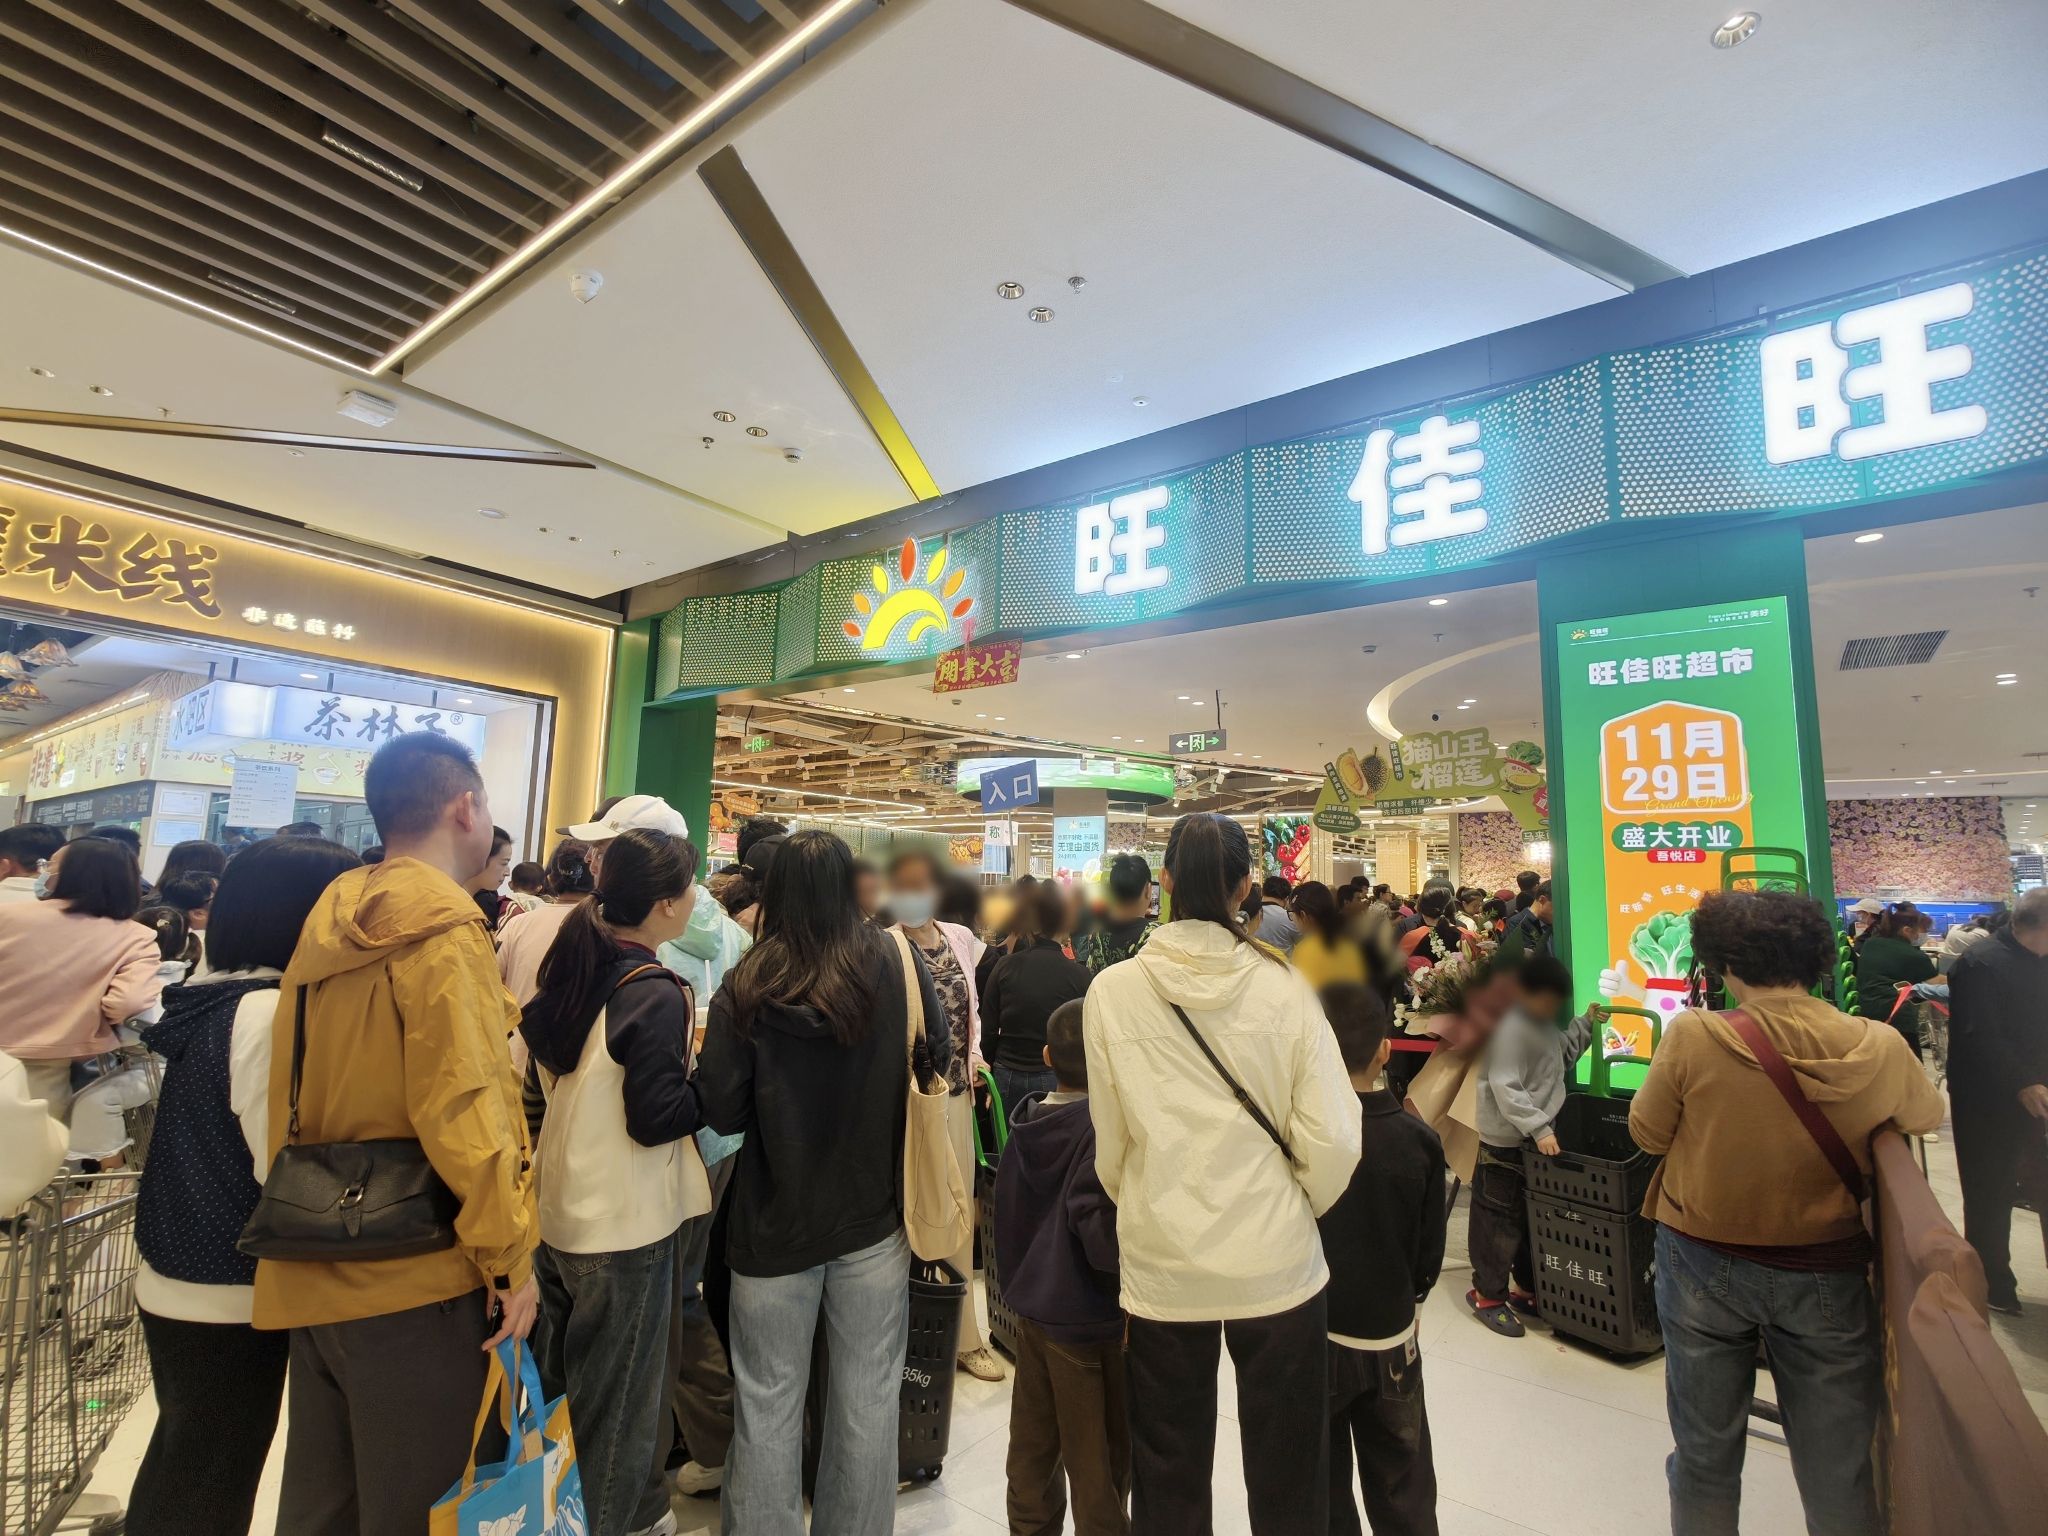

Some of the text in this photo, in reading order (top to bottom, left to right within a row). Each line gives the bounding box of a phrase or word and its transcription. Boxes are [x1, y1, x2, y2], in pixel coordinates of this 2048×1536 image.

[939, 649, 1017, 683] 開業大吉
[1588, 646, 1754, 686] 旺佳旺超市
[1402, 732, 1490, 766] 猫山王
[1616, 720, 1724, 761] 11月
[988, 774, 1032, 805] 入口
[1411, 757, 1494, 791] 榴莲
[1621, 763, 1725, 802] 29日
[1645, 797, 1690, 817] Grand
[1058, 842, 1100, 852] 无理由退货
[1523, 832, 1550, 842] 马来
[1622, 825, 1732, 849] 盛大开业
[1656, 850, 1697, 861] 吾悦店
[1545, 1253, 1608, 1287] 旺佳旺
[902, 1366, 932, 1388] 35kg
